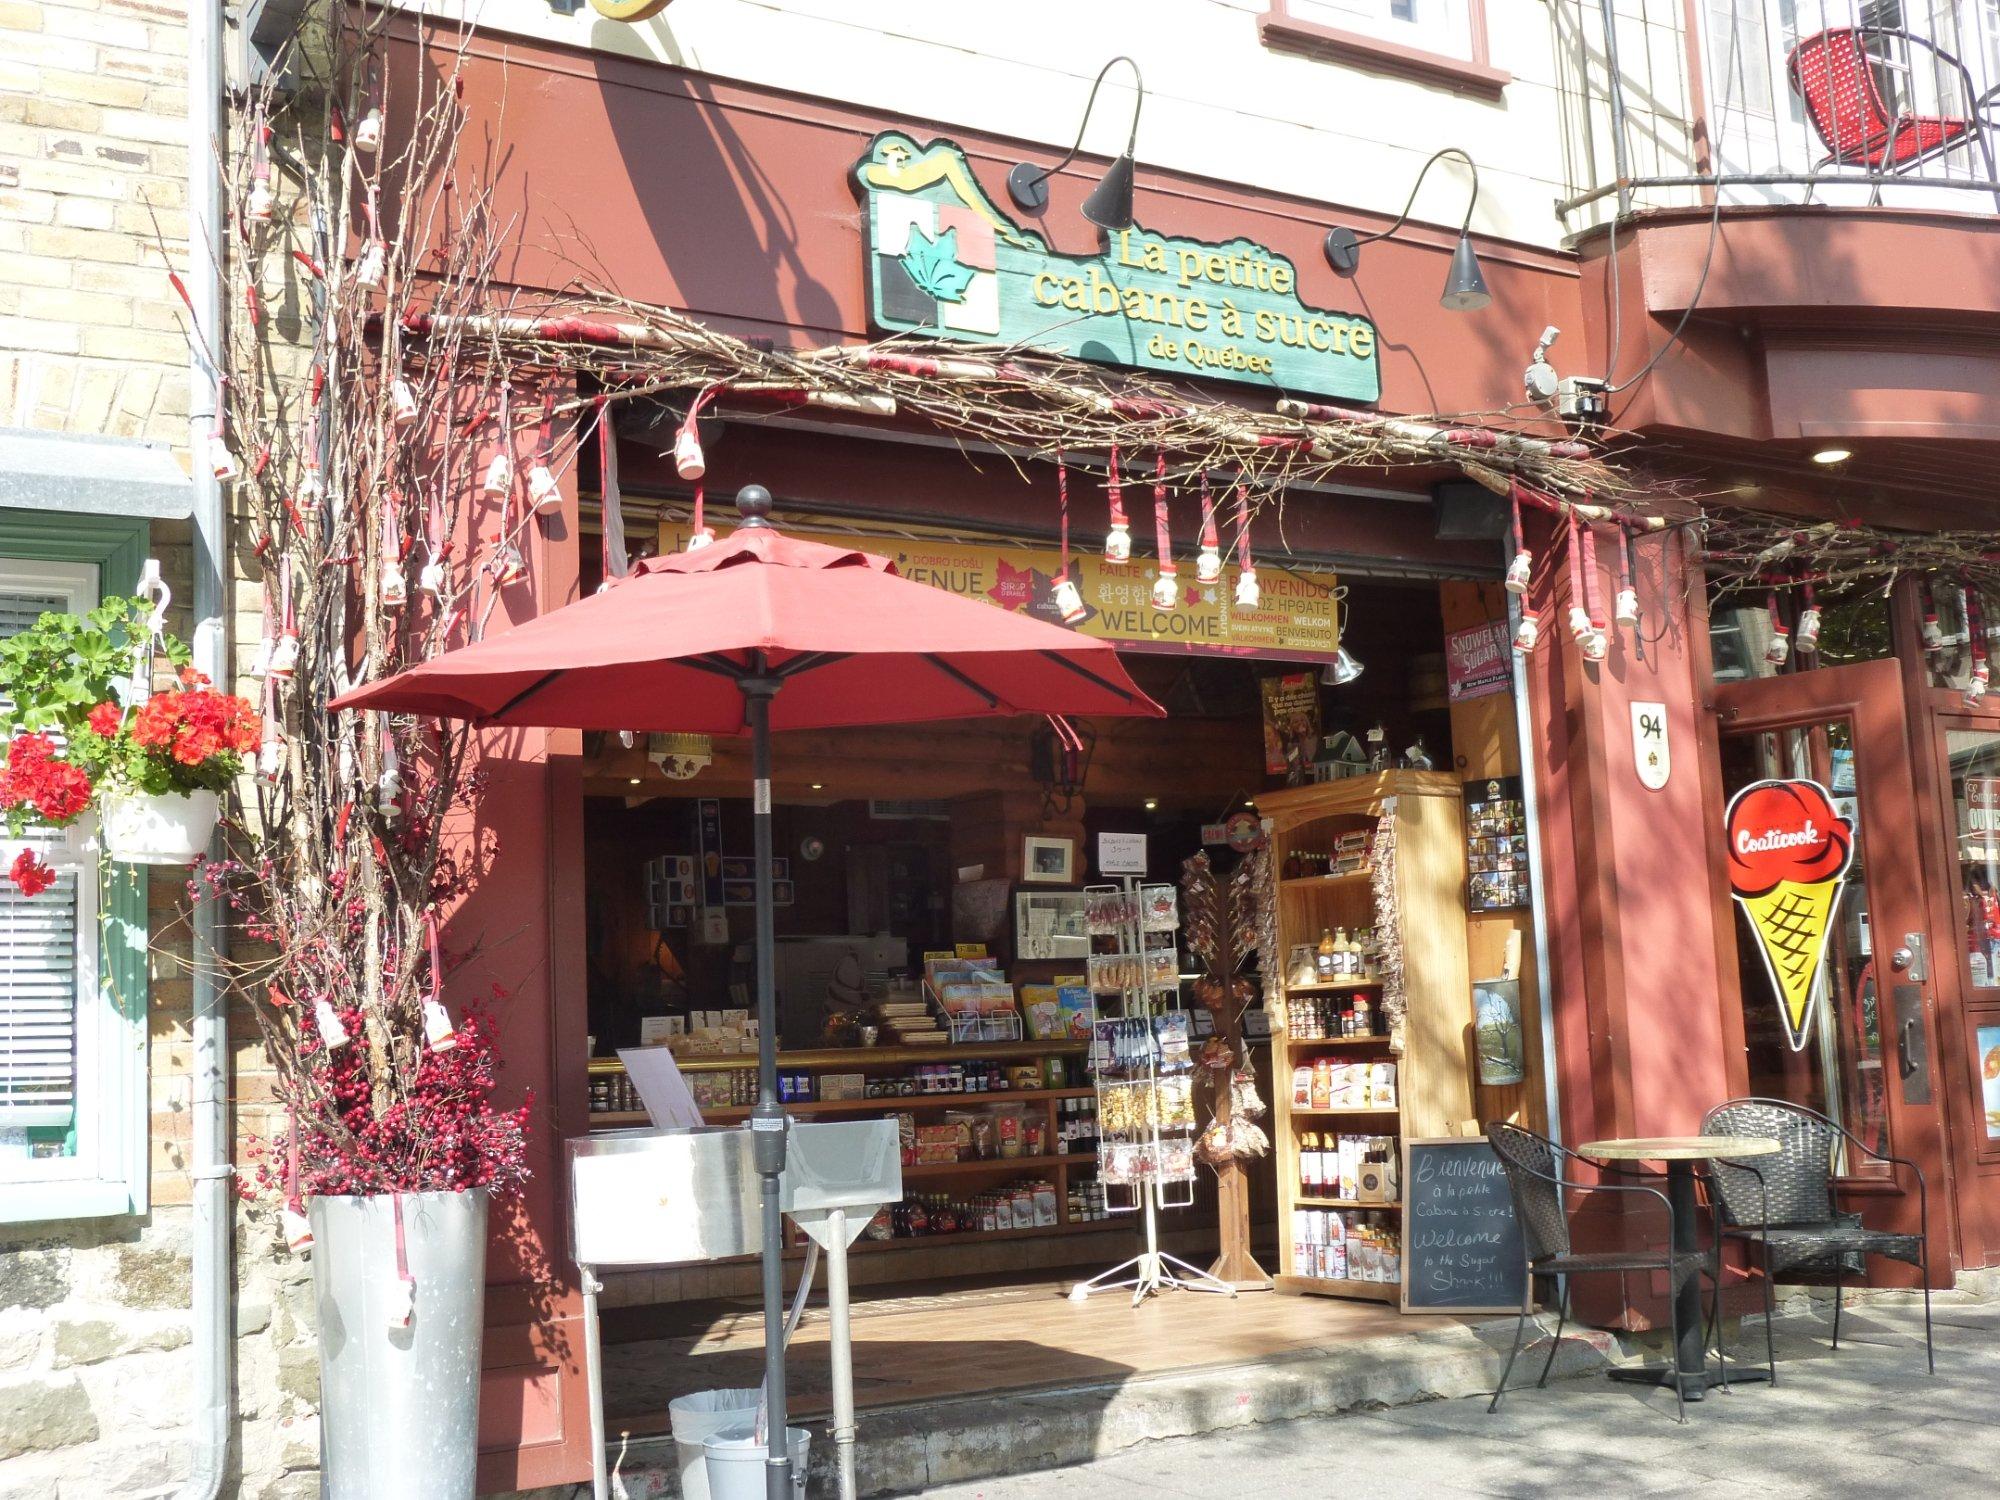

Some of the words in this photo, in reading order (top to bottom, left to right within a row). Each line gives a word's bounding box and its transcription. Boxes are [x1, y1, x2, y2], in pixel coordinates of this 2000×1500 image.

[1119, 229, 1167, 271] La
[1179, 244, 1292, 294] petite
[1034, 266, 1209, 330] cabane
[1222, 295, 1245, 337] à
[1255, 308, 1374, 358] sucre
[1148, 333, 1177, 361] de
[1183, 340, 1273, 375] Québec
[913, 555, 951, 567] DOBRO
[1098, 583, 1153, 606] 환영합
[1229, 575, 1330, 599] BNVENIDO
[1100, 609, 1220, 638] WELCOME
[1230, 611, 1289, 624] WILLKOMMEN
[1294, 615, 1331, 628] WELKOM
[1276, 626, 1332, 640] BENVENUTO
[1463, 644, 1499, 675] SUGAR
[1640, 714, 1662, 739] 94
[1737, 820, 1818, 854] Coaticook
[1417, 1154, 1507, 1183] Bienvenue
[1414, 1229, 1502, 1249] Welcome
[1424, 1257, 1434, 1267] to
[1440, 1254, 1453, 1266] the
[1459, 1253, 1497, 1273] Sugar
